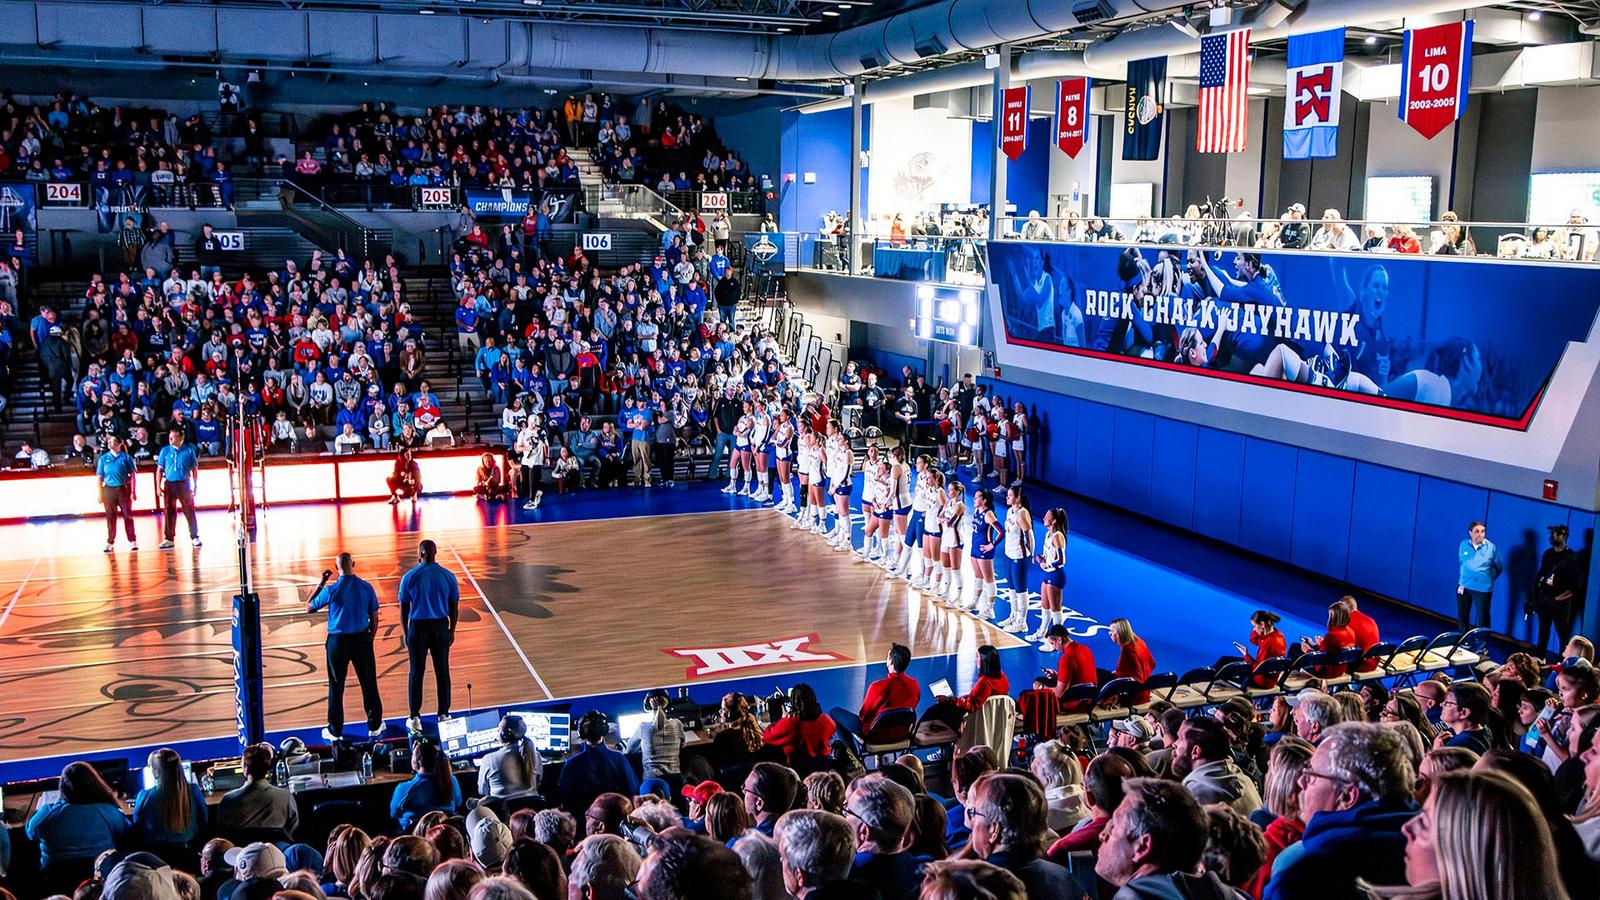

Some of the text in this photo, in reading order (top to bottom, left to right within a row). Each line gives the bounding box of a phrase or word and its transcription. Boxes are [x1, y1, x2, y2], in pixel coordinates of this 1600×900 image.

[1424, 46, 1447, 57] LIMA
[1418, 63, 1450, 92] 10
[1065, 94, 1081, 102] PAYNE
[1409, 97, 1455, 110] 2002-2005
[1067, 106, 1077, 126] 8
[1128, 87, 1137, 135] KANSAS
[1008, 112, 1020, 131] 11
[1060, 130, 1083, 138] 2014-2017
[48, 186, 80, 198] 204
[423, 190, 449, 202] 205
[703, 195, 726, 206] 206
[475, 202, 528, 213] CHAMPIONS
[220, 234, 240, 248] 05
[585, 236, 608, 248] 106
[1085, 289, 1360, 347] ROCK CHALK JAYHAWK
[232, 648, 248, 747] KANSAS
